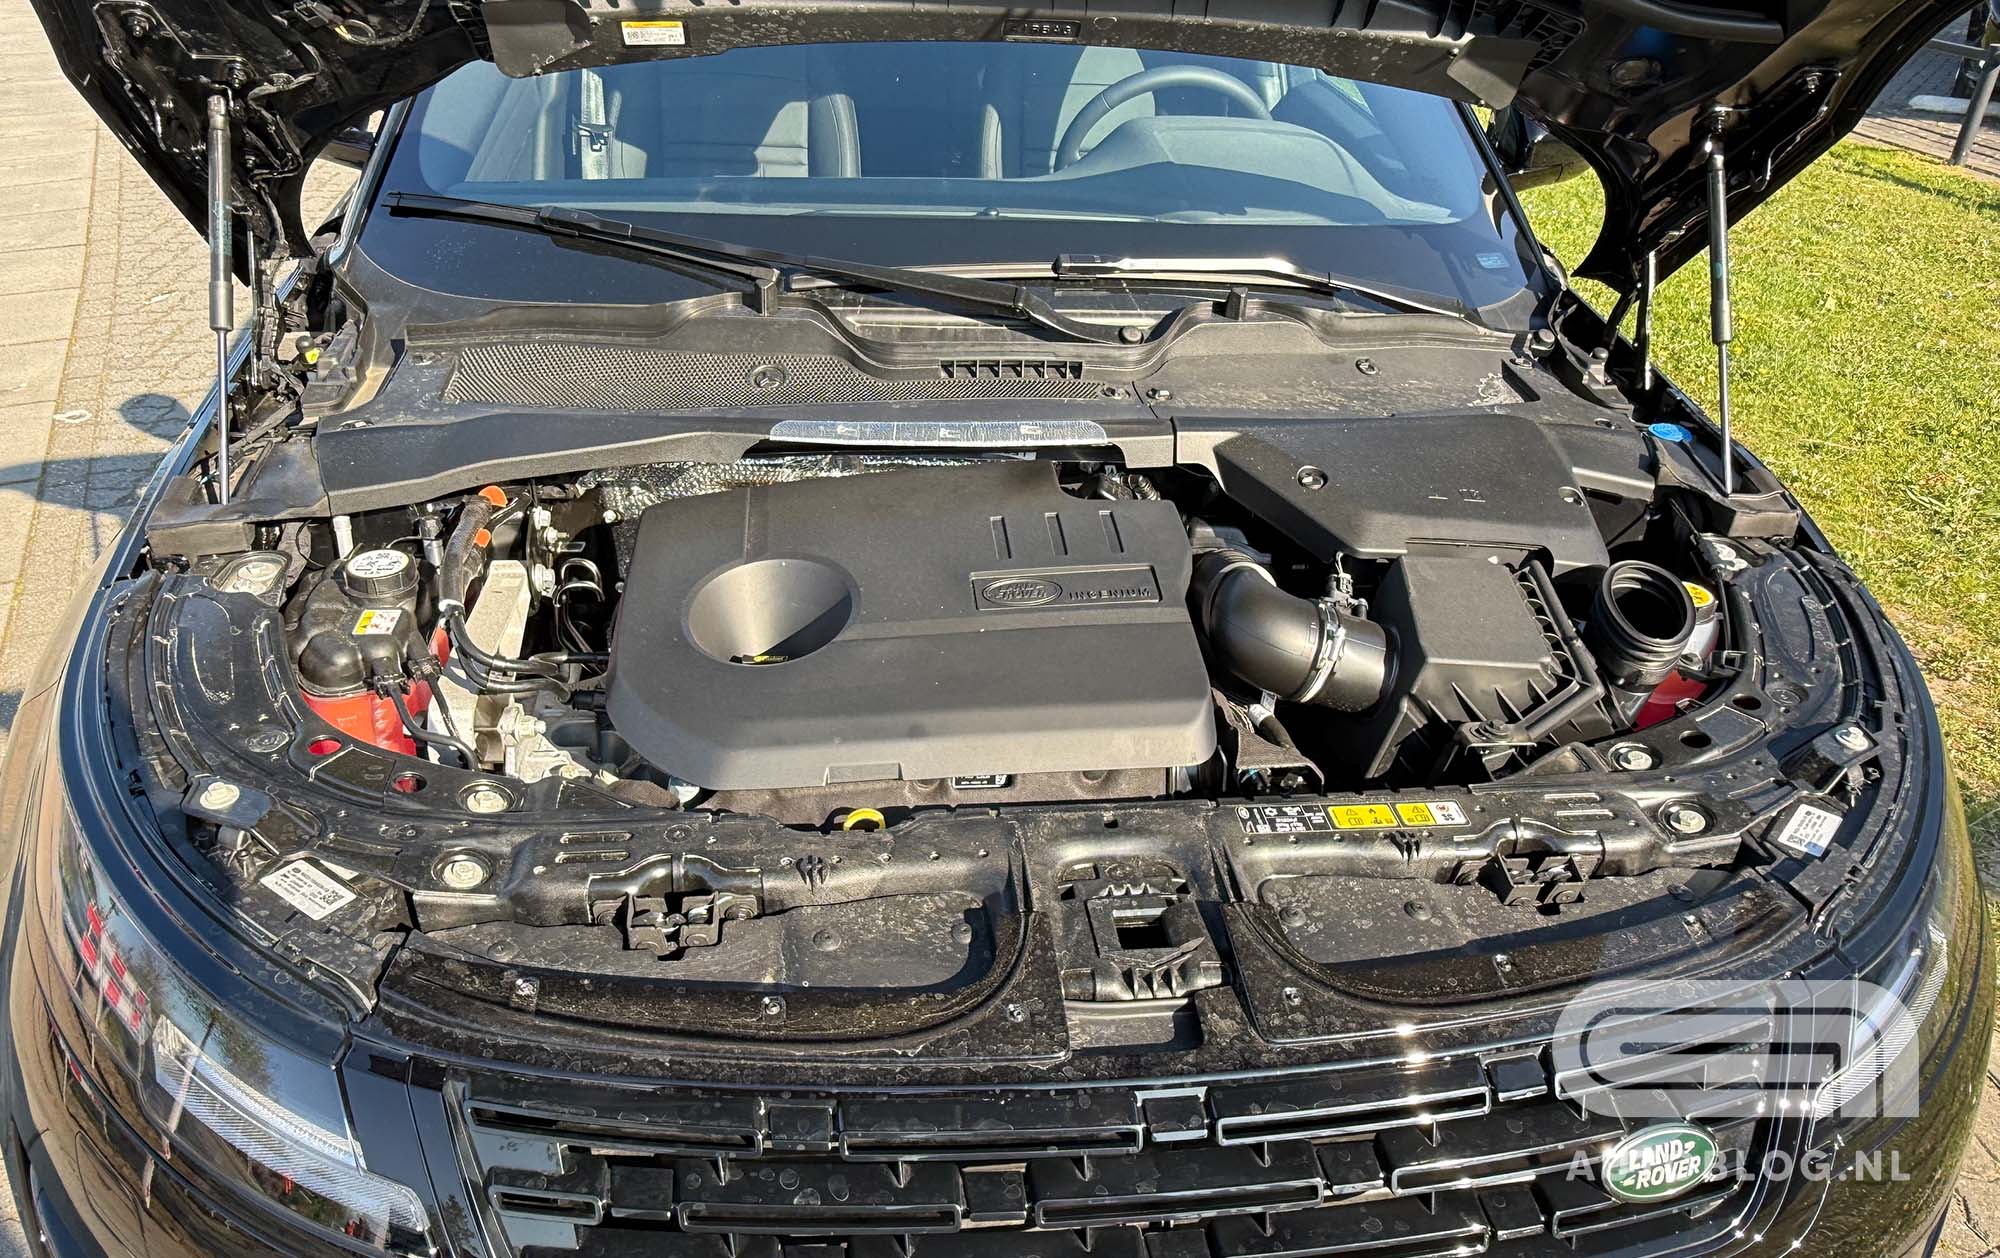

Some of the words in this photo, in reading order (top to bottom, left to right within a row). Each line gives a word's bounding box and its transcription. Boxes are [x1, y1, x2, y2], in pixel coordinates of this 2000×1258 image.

[1069, 586, 1151, 600] INGENIUM
[1628, 1139, 1683, 1171] LAND
[1635, 1155, 1701, 1190] ROVER
